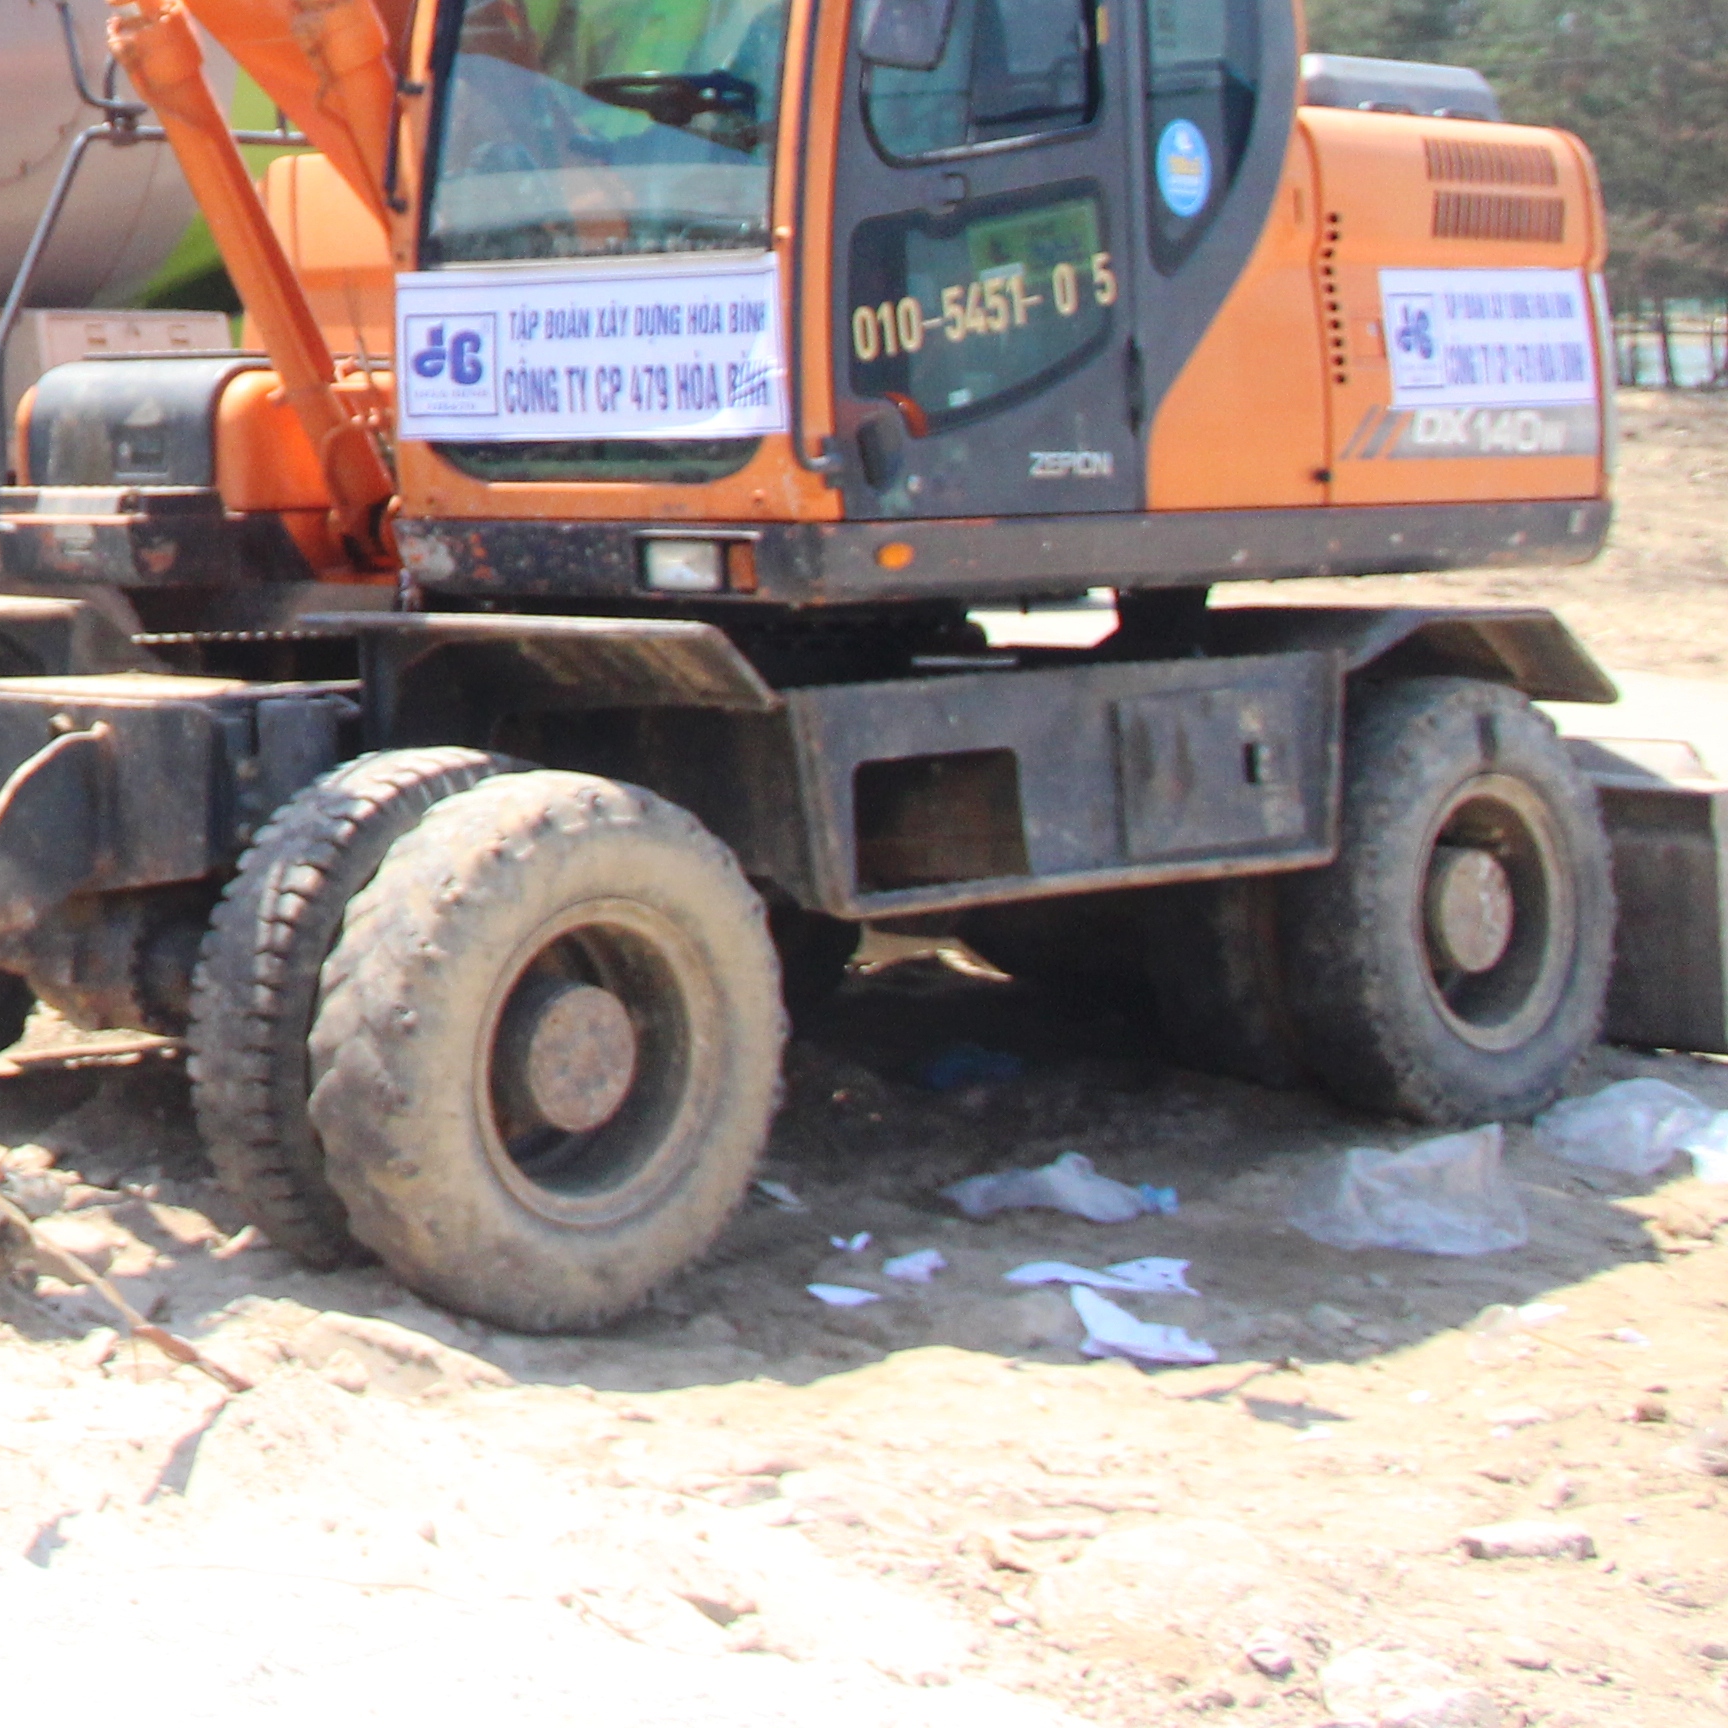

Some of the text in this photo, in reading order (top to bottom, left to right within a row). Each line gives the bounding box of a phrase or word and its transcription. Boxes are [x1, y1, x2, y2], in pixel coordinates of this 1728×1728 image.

[595, 300, 628, 339] XÂY
[503, 356, 559, 415] CÔNG
[563, 364, 587, 414] TY
[593, 364, 622, 413] CP
[629, 363, 670, 411] 479
